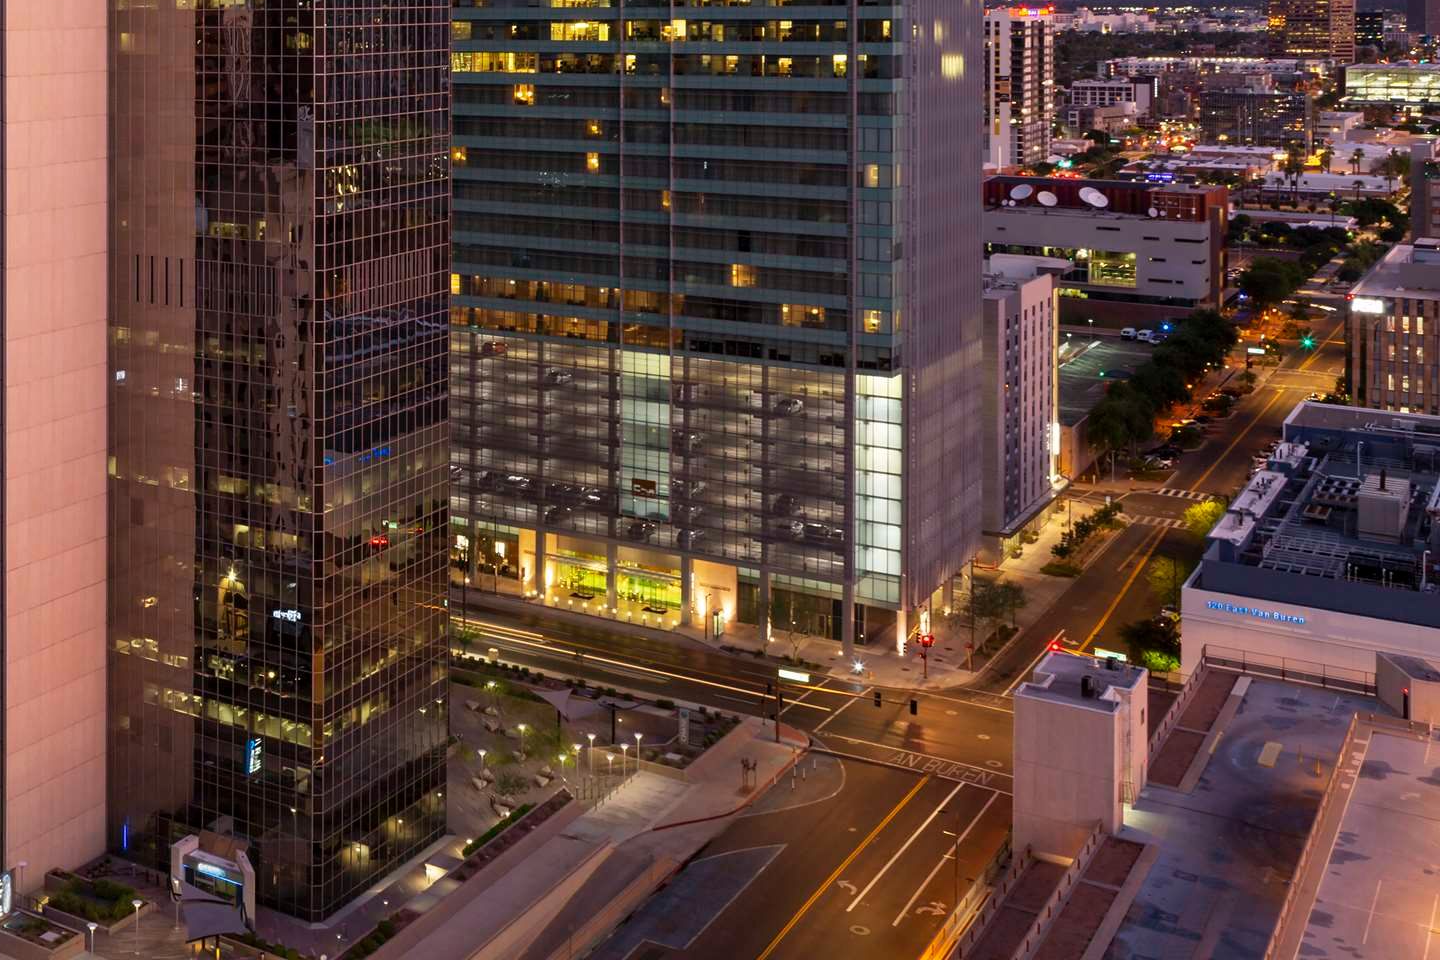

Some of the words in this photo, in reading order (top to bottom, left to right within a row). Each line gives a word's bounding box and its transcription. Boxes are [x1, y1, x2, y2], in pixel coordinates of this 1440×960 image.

[1207, 600, 1223, 610] 120
[1225, 604, 1248, 615] East
[1251, 608, 1270, 619] Van
[1273, 611, 1305, 624] Buren
